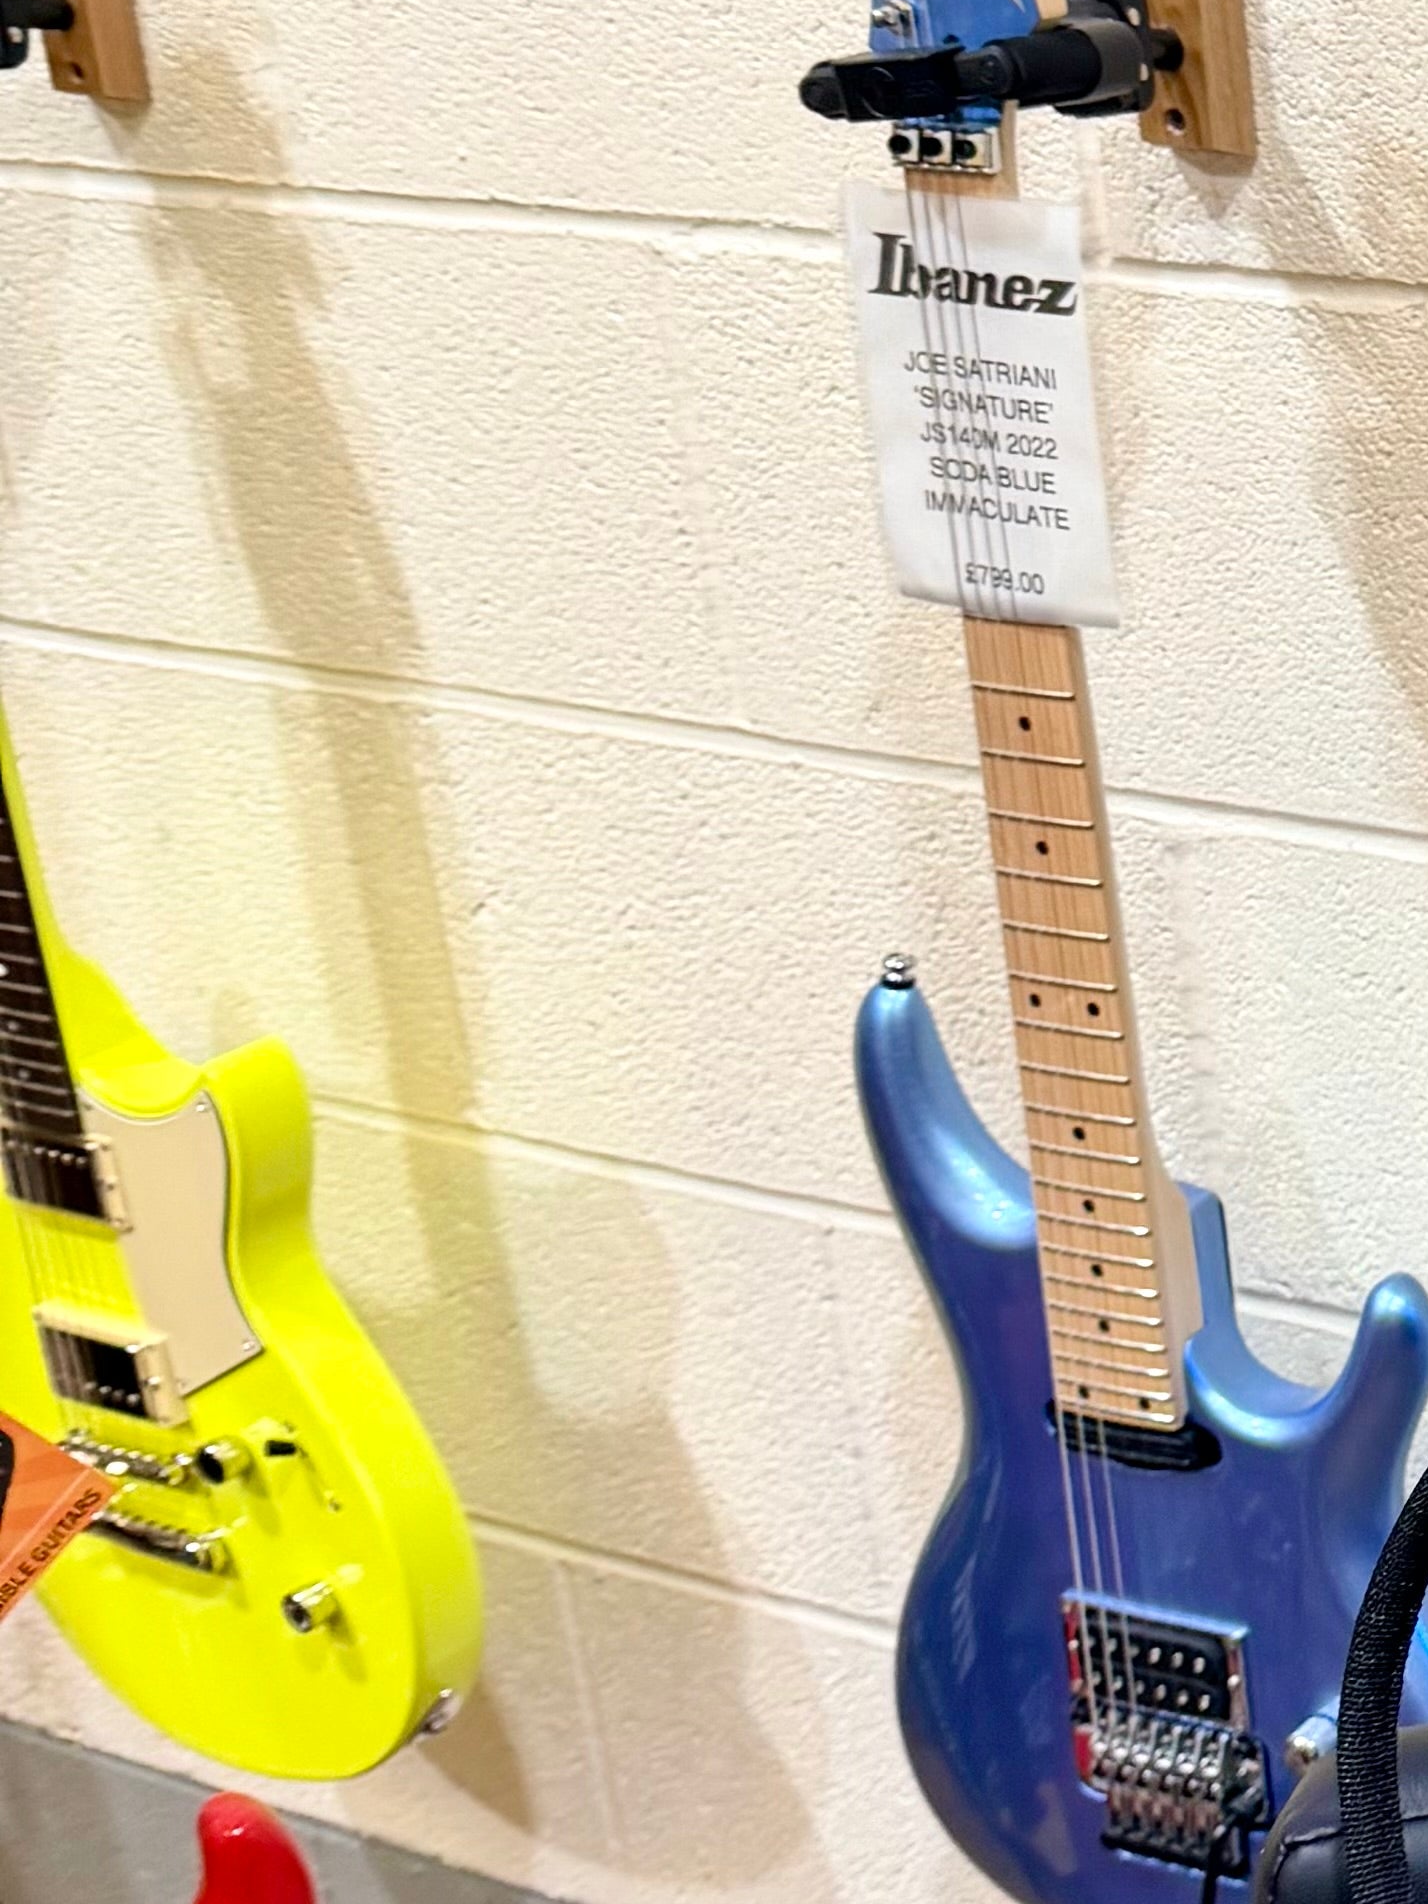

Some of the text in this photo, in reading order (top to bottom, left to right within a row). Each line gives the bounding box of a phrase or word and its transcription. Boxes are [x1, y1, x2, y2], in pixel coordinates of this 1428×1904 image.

[867, 231, 1079, 317] Ibanez
[904, 351, 1057, 390] JOE SATRIANI
[1006, 433, 1059, 460] 2022
[929, 456, 1056, 494] SODA BLUE
[925, 490, 1071, 531] IMMACULATE
[965, 562, 1045, 595] £799.00
[31, 1487, 101, 1563] GUITARS
